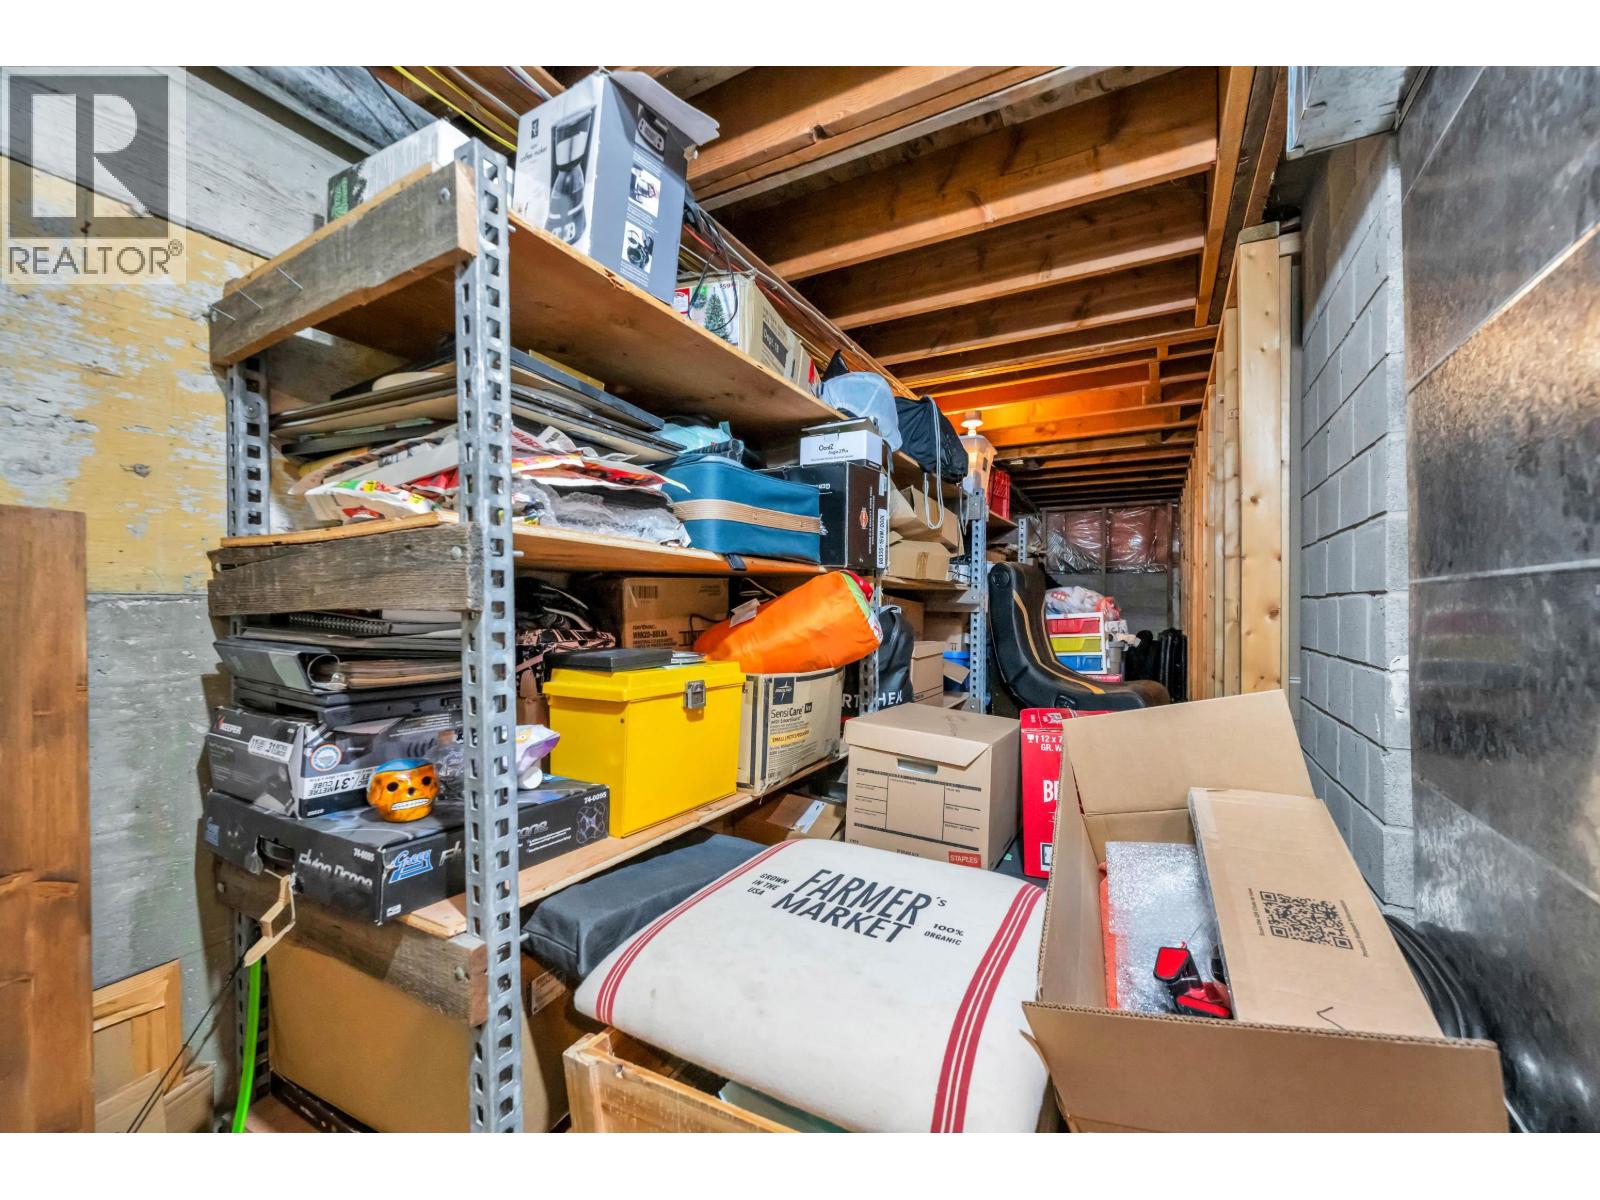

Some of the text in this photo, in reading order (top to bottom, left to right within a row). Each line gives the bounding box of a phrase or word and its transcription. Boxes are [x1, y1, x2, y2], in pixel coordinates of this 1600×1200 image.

[950, 855, 979, 864] STAPLES
[760, 873, 790, 885] GROWN
[747, 887, 765, 896] USA
[762, 882, 781, 891] THE
[771, 893, 912, 943] MARKET
[932, 923, 965, 937] 100%
[924, 930, 962, 947] ORGANIC
